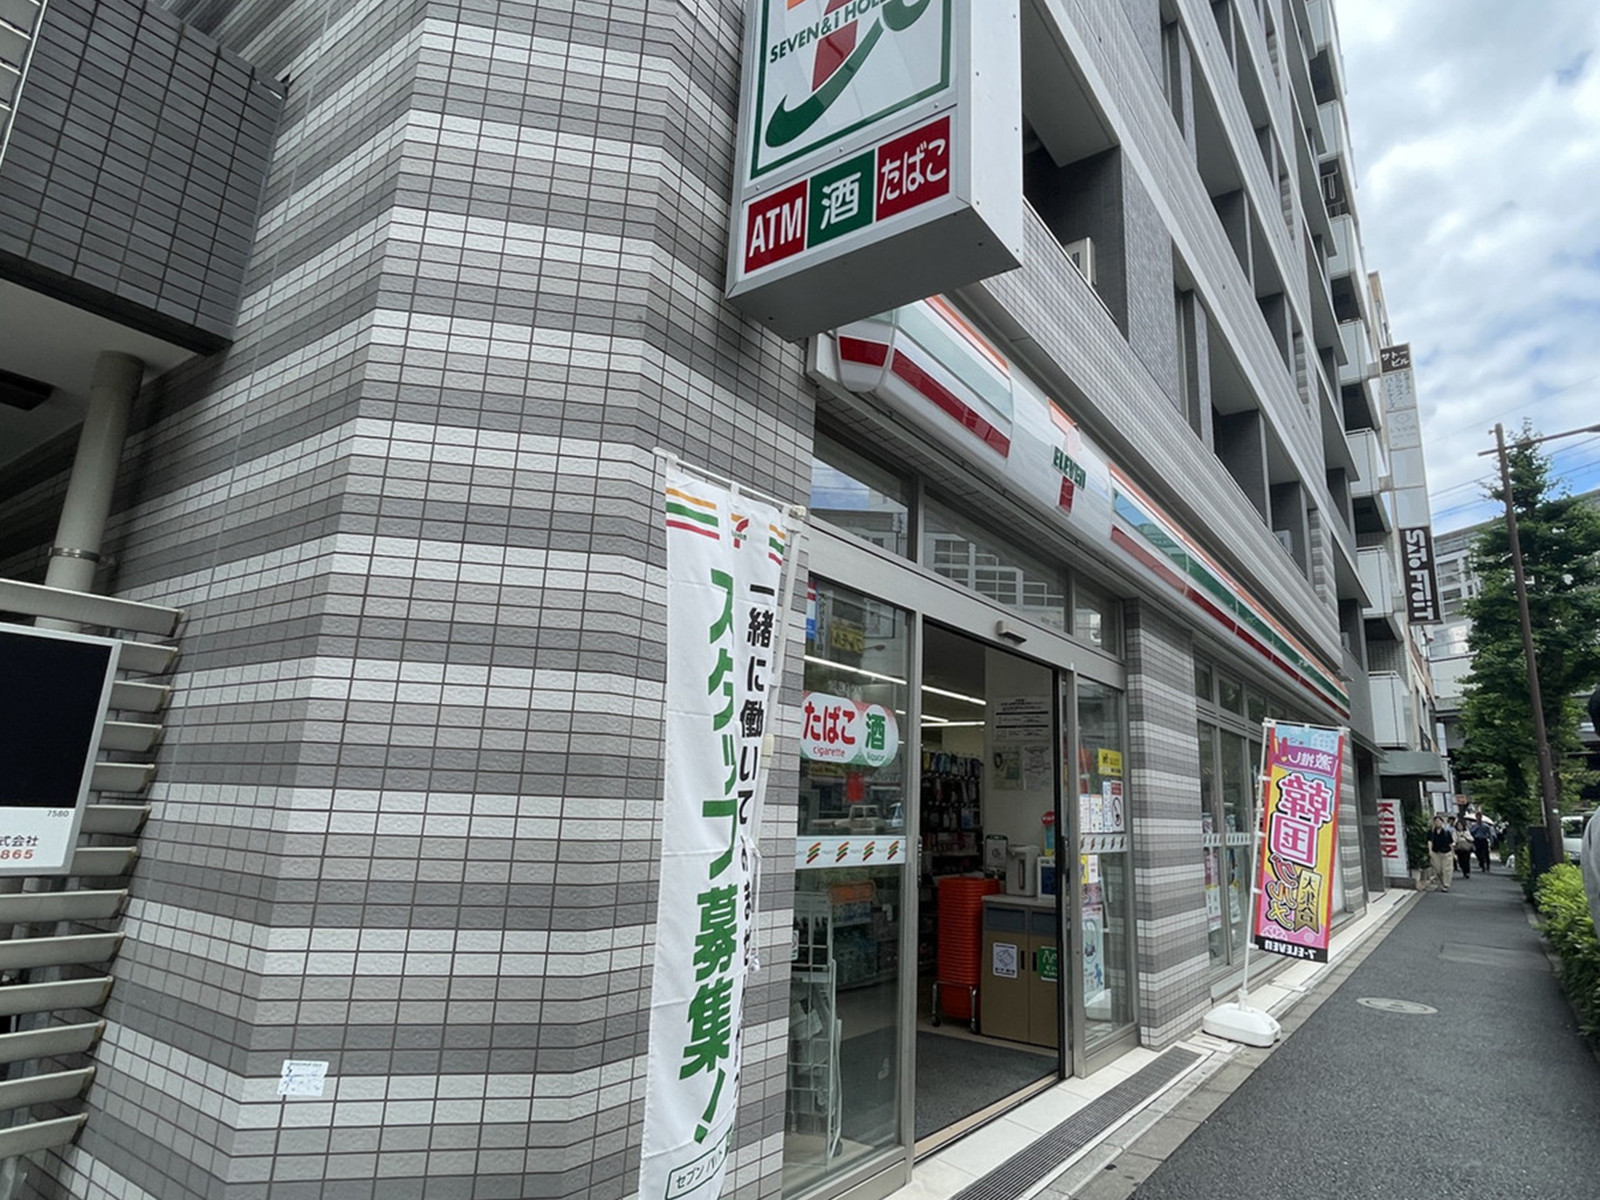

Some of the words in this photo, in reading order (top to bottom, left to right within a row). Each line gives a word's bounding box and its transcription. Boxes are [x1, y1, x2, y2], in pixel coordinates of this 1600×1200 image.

[844, 0, 887, 23] HOL
[879, 138, 948, 205] たばこ
[819, 171, 863, 231] 酒
[748, 196, 804, 258] ATM
[1380, 349, 1409, 362] サトー
[1391, 357, 1410, 368] ビル
[803, 701, 856, 745] たばこ
[865, 712, 886, 751] 酒
[1376, 802, 1399, 858] KIRIN
[0, 848, 34, 861] 865
